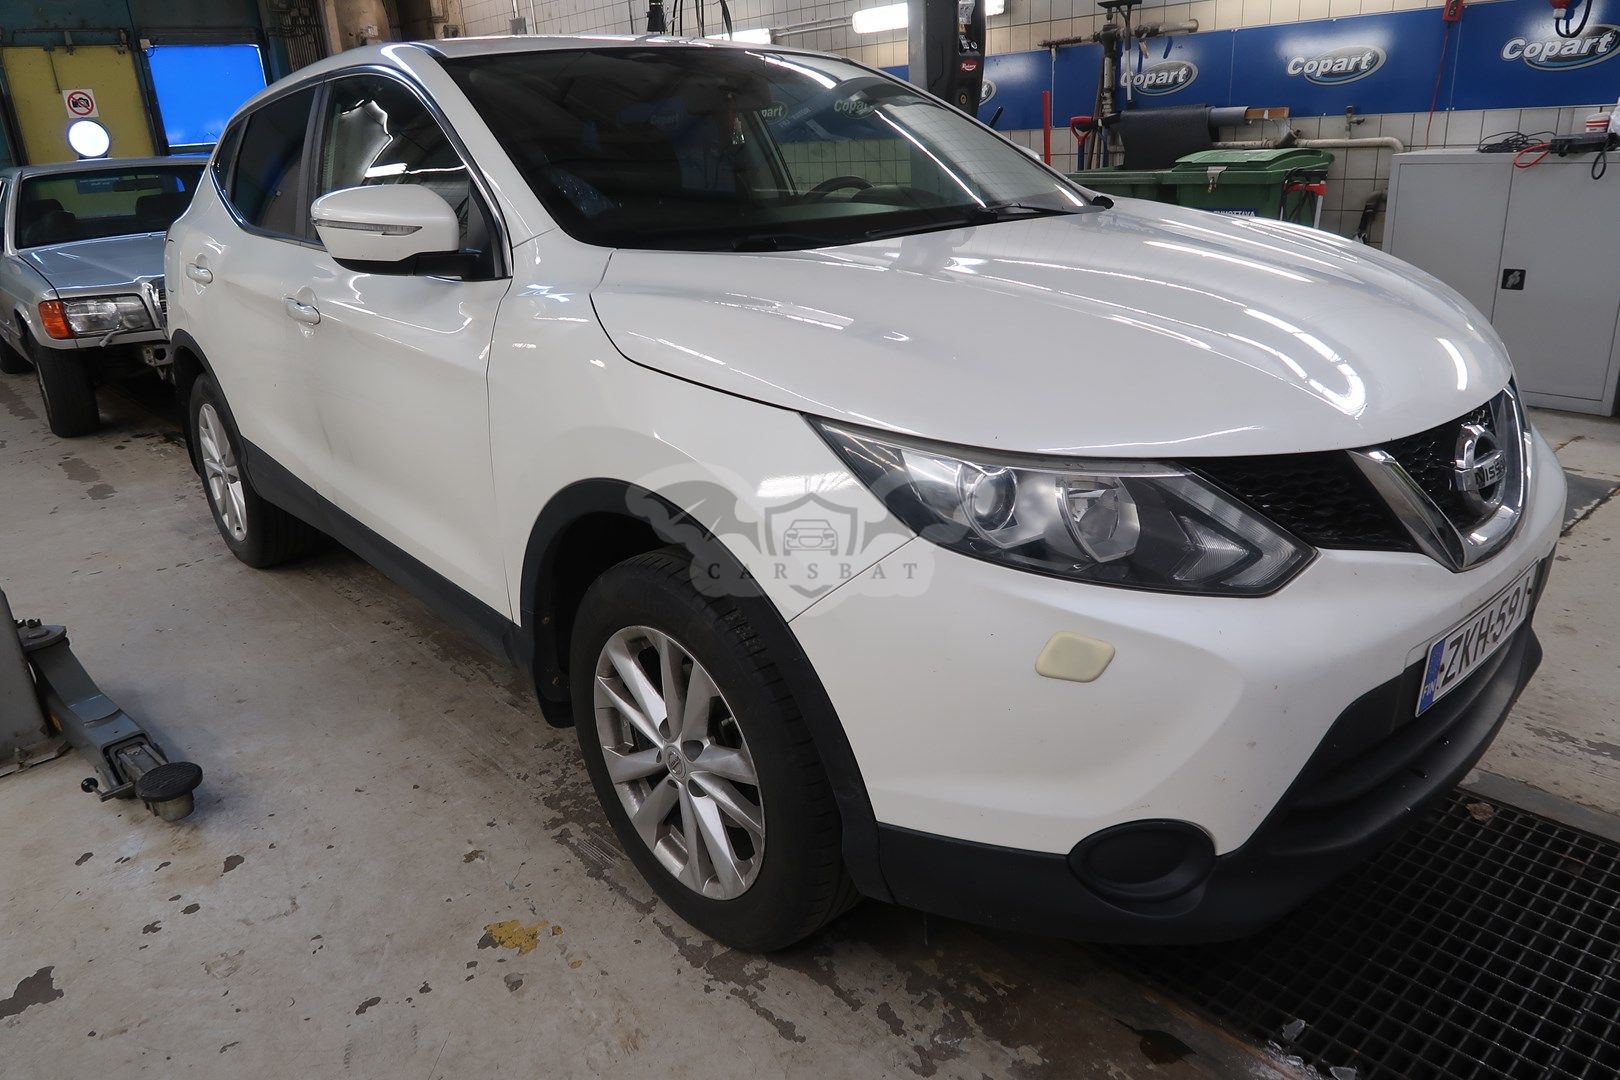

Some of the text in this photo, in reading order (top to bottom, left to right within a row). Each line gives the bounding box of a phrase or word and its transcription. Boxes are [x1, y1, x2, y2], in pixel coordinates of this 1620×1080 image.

[1502, 31, 1615, 62] Copart
[1120, 66, 1188, 89] Copart
[1286, 51, 1373, 77] Copart
[1440, 576, 1531, 687] ZKH-591
